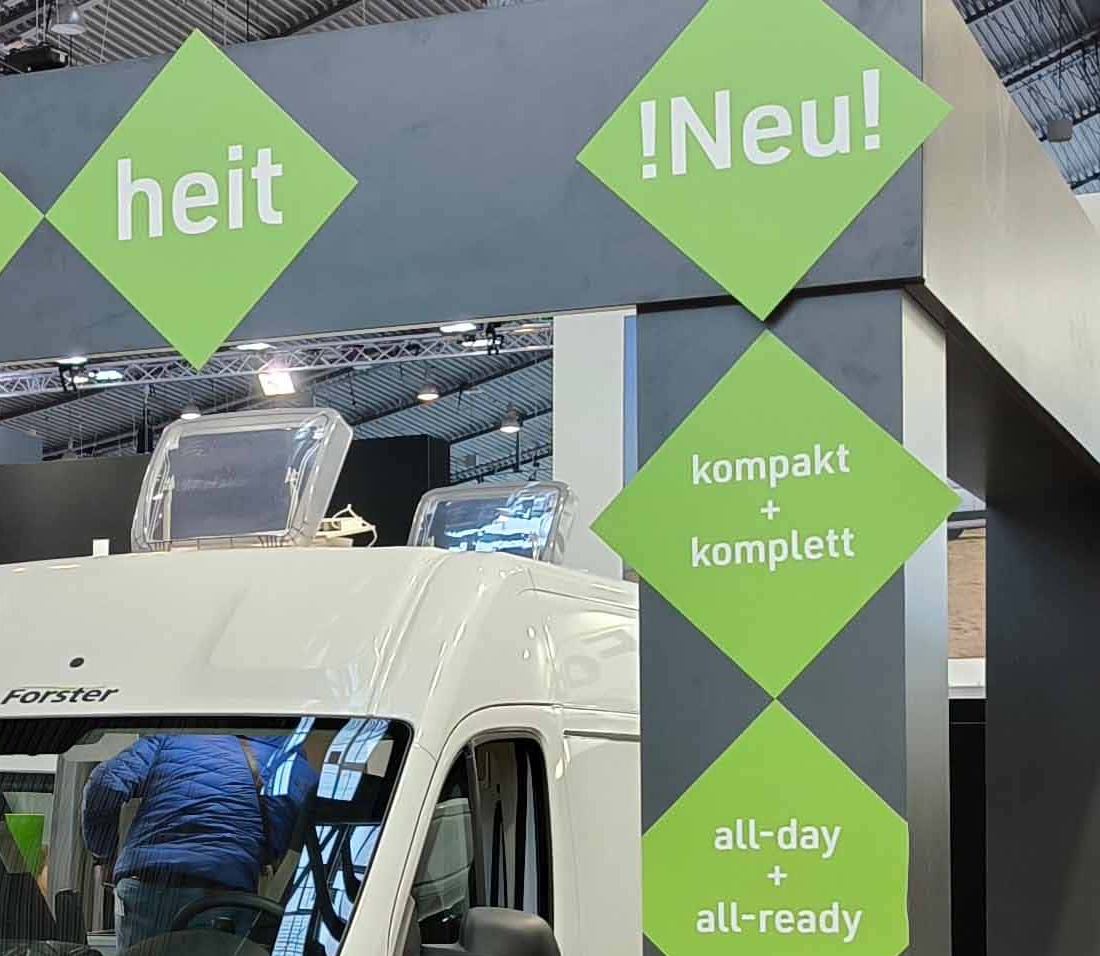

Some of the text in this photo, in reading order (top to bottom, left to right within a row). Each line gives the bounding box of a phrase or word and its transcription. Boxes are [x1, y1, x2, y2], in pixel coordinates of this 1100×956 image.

[634, 68, 881, 180] !Neu!
[116, 144, 284, 241] heit
[691, 442, 851, 489] kompakt
[759, 500, 781, 521] +
[690, 526, 856, 573] komplett
[0, 685, 119, 706] Forster
[714, 818, 842, 860] all-day
[767, 865, 788, 887] +
[695, 901, 863, 943] all-ready
